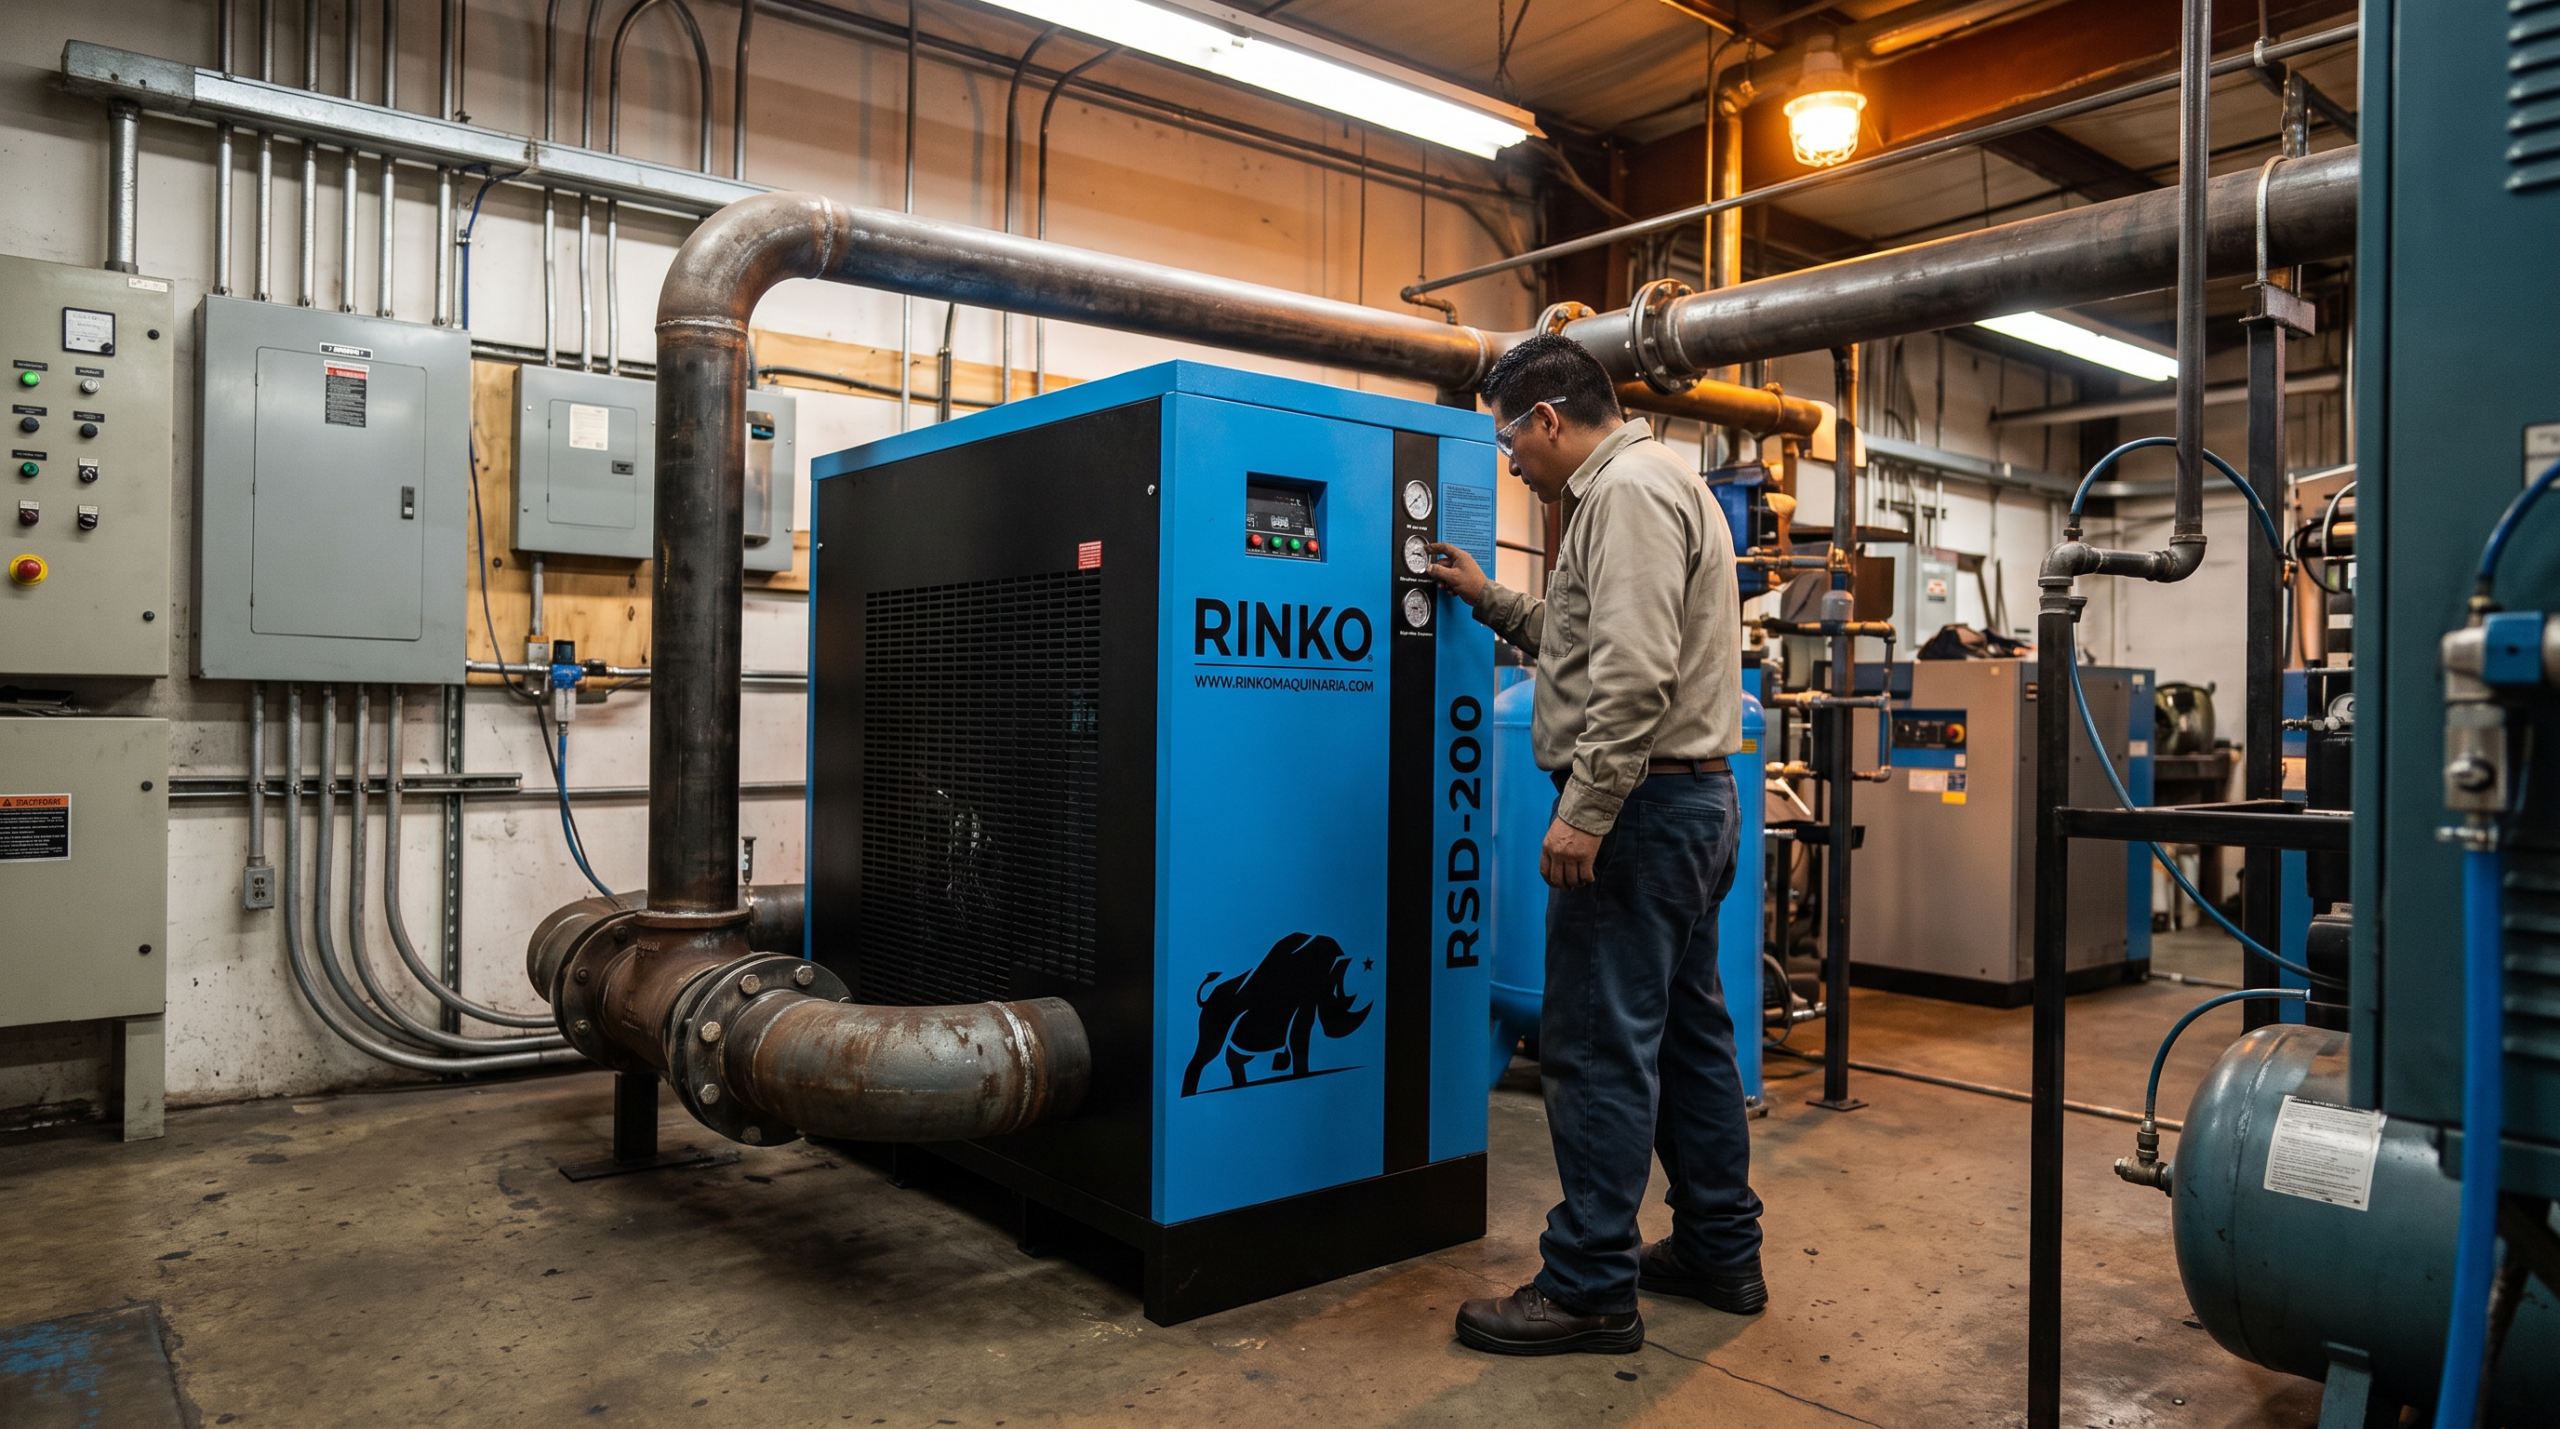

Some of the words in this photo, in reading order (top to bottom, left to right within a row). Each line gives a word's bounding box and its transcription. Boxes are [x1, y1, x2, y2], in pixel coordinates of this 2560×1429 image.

[1195, 598, 1373, 662] RINKO
[1195, 674, 1374, 692] WWW.RINKOMAQUINARIA.COM
[1446, 695, 1482, 969] RSD-200
